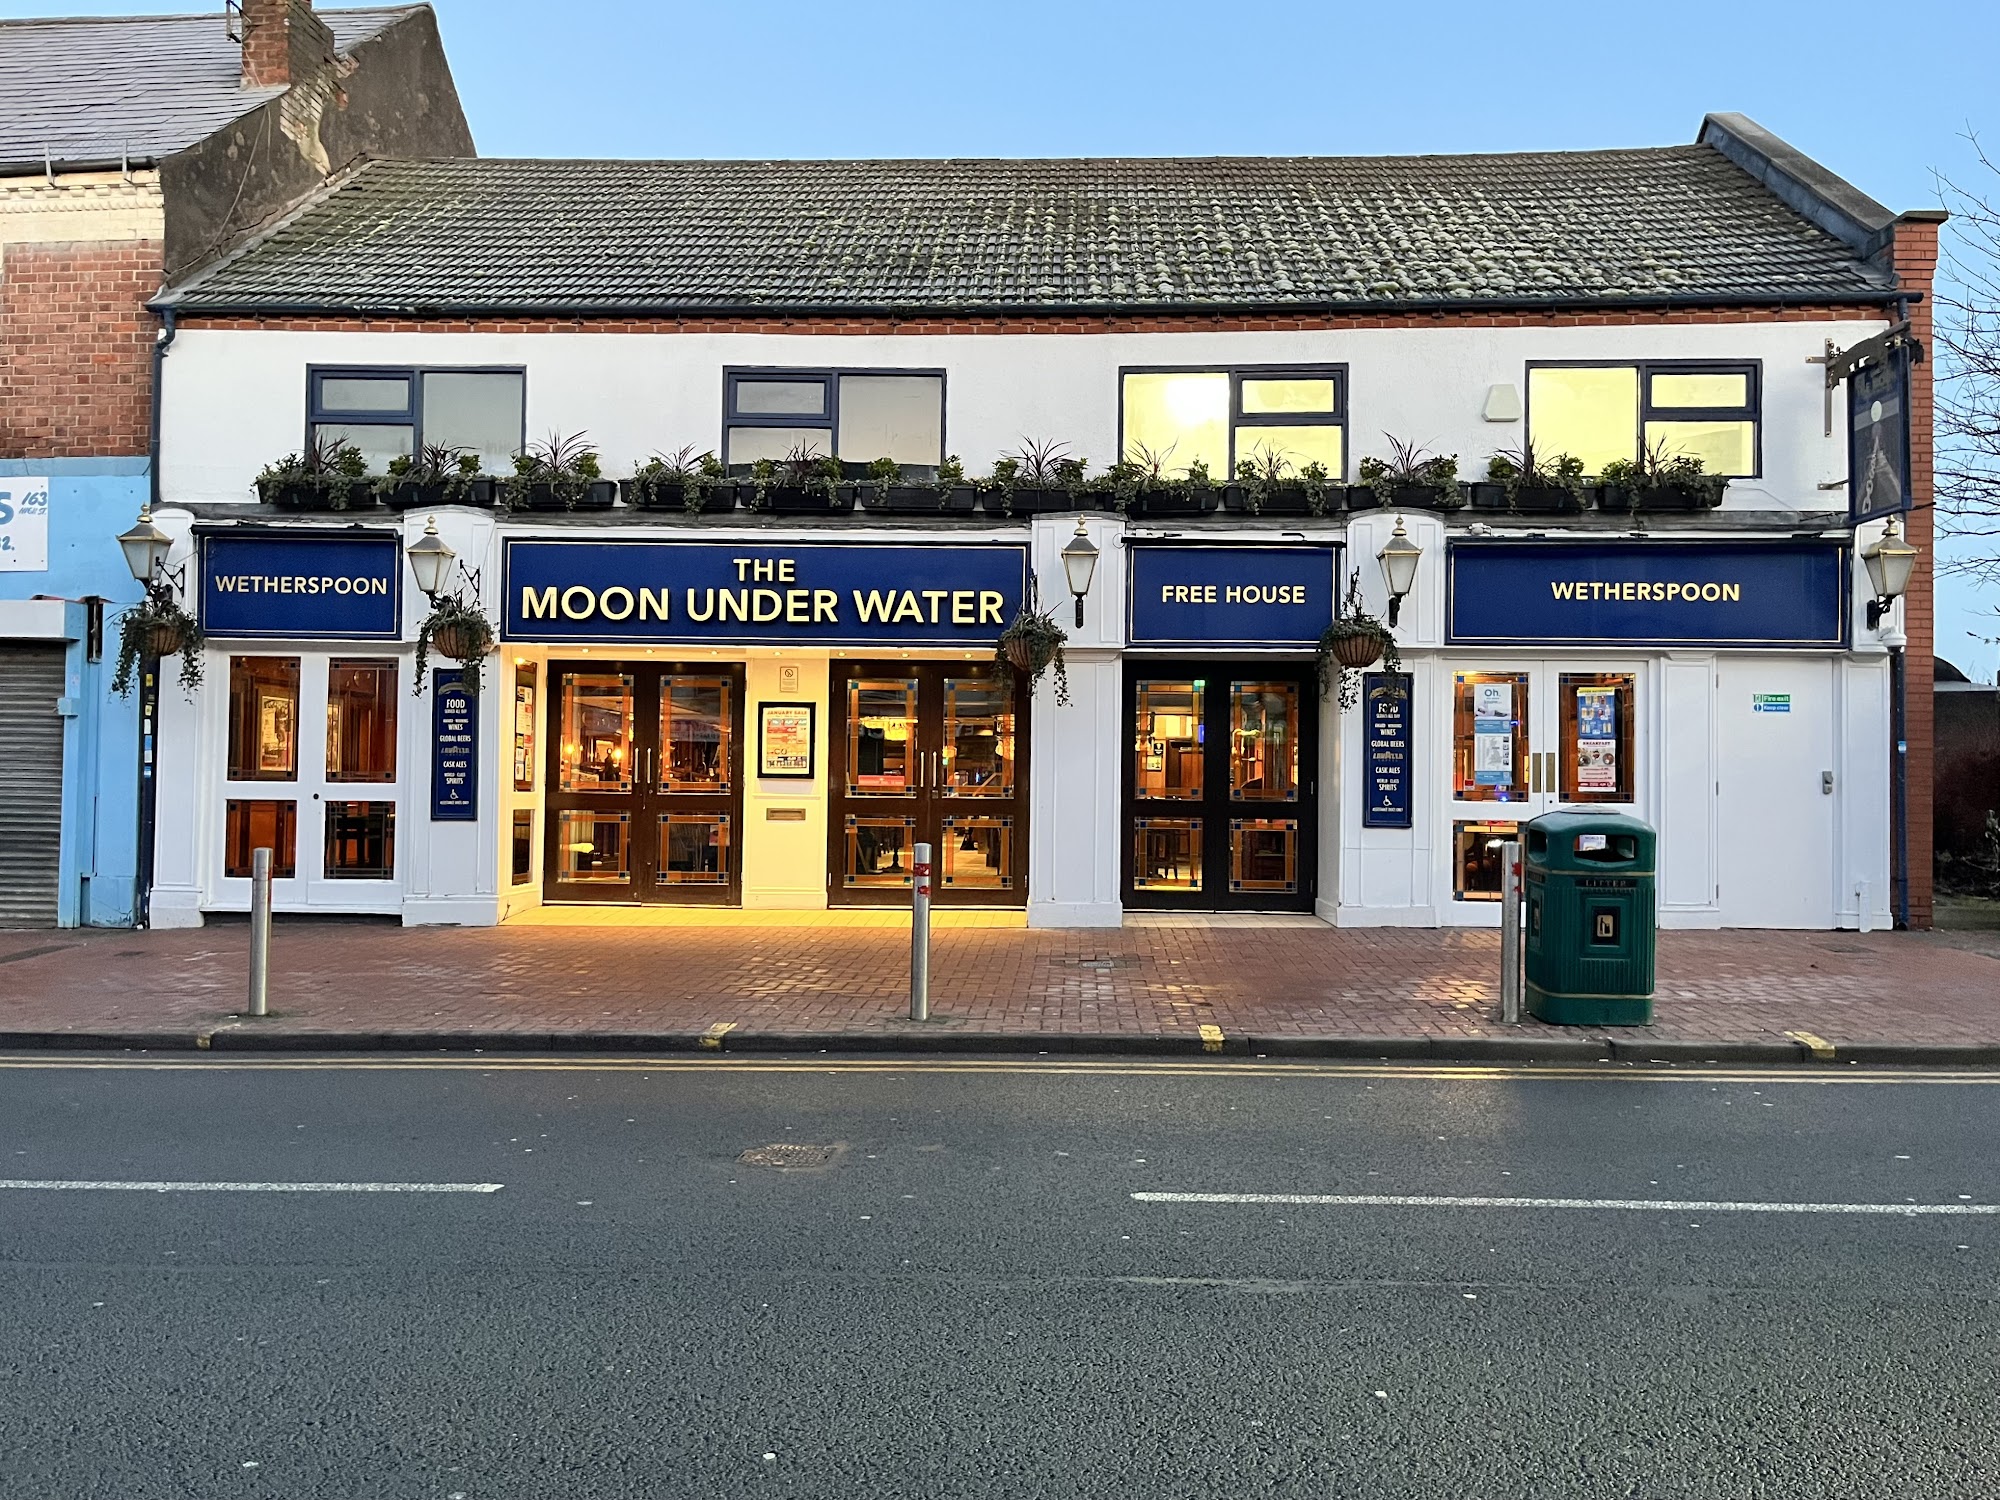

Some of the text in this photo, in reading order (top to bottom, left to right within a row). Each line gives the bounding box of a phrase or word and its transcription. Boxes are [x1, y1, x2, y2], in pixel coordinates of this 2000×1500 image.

[21, 491, 48, 506] 163
[733, 558, 795, 582] THE
[215, 575, 388, 595] WETHERSPOON
[1162, 585, 1306, 604] FREE HOUSE
[1551, 581, 1740, 602] WETHERSPOON
[521, 585, 1004, 624] MOON UNDER WATER
[446, 699, 466, 709] FOOD
